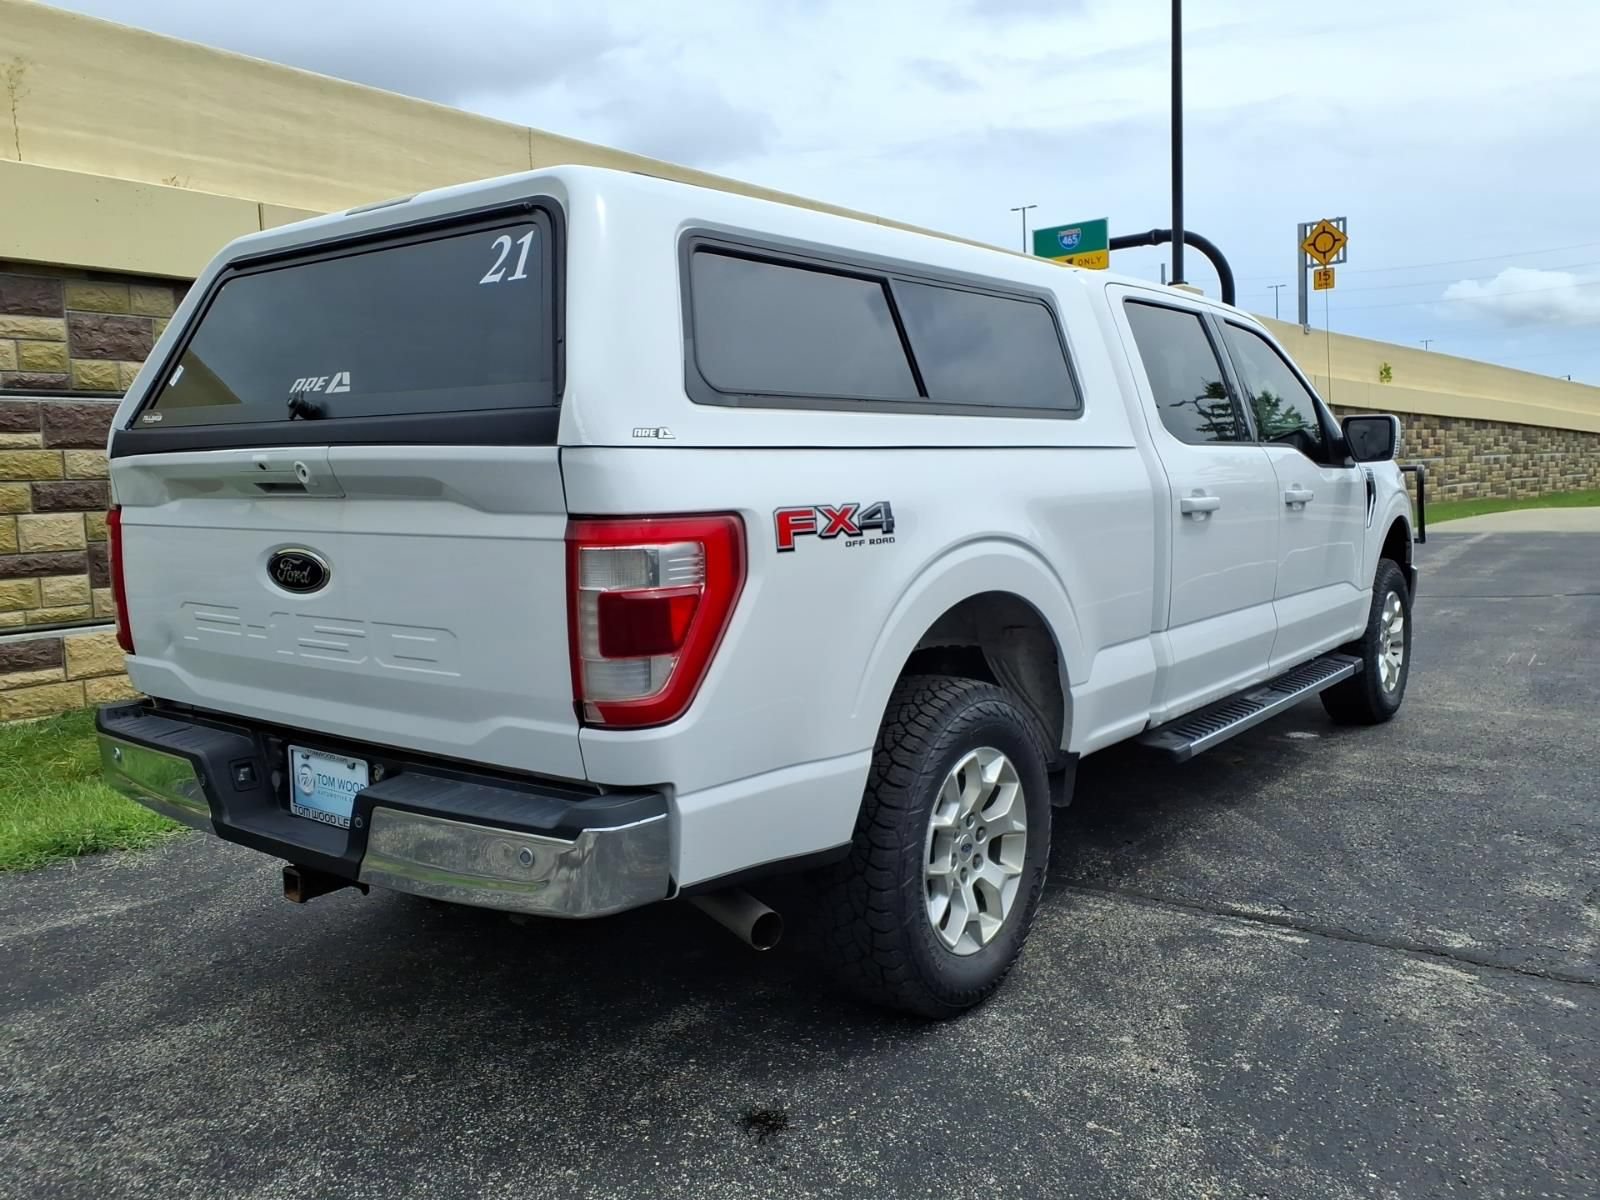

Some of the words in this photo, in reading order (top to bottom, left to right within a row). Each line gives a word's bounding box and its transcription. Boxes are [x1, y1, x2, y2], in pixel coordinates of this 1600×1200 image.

[1062, 234, 1078, 246] 465
[479, 230, 534, 284] 21
[1078, 256, 1102, 266] ONLY
[1318, 270, 1331, 281] 15
[289, 376, 329, 393] ARE
[773, 501, 895, 552] FX4
[845, 540, 865, 548] OFF
[869, 536, 896, 546] ROAD
[276, 557, 312, 585] Ford
[316, 773, 335, 789] TOM
[294, 805, 310, 818] TOM
[312, 809, 336, 825] WOOD
